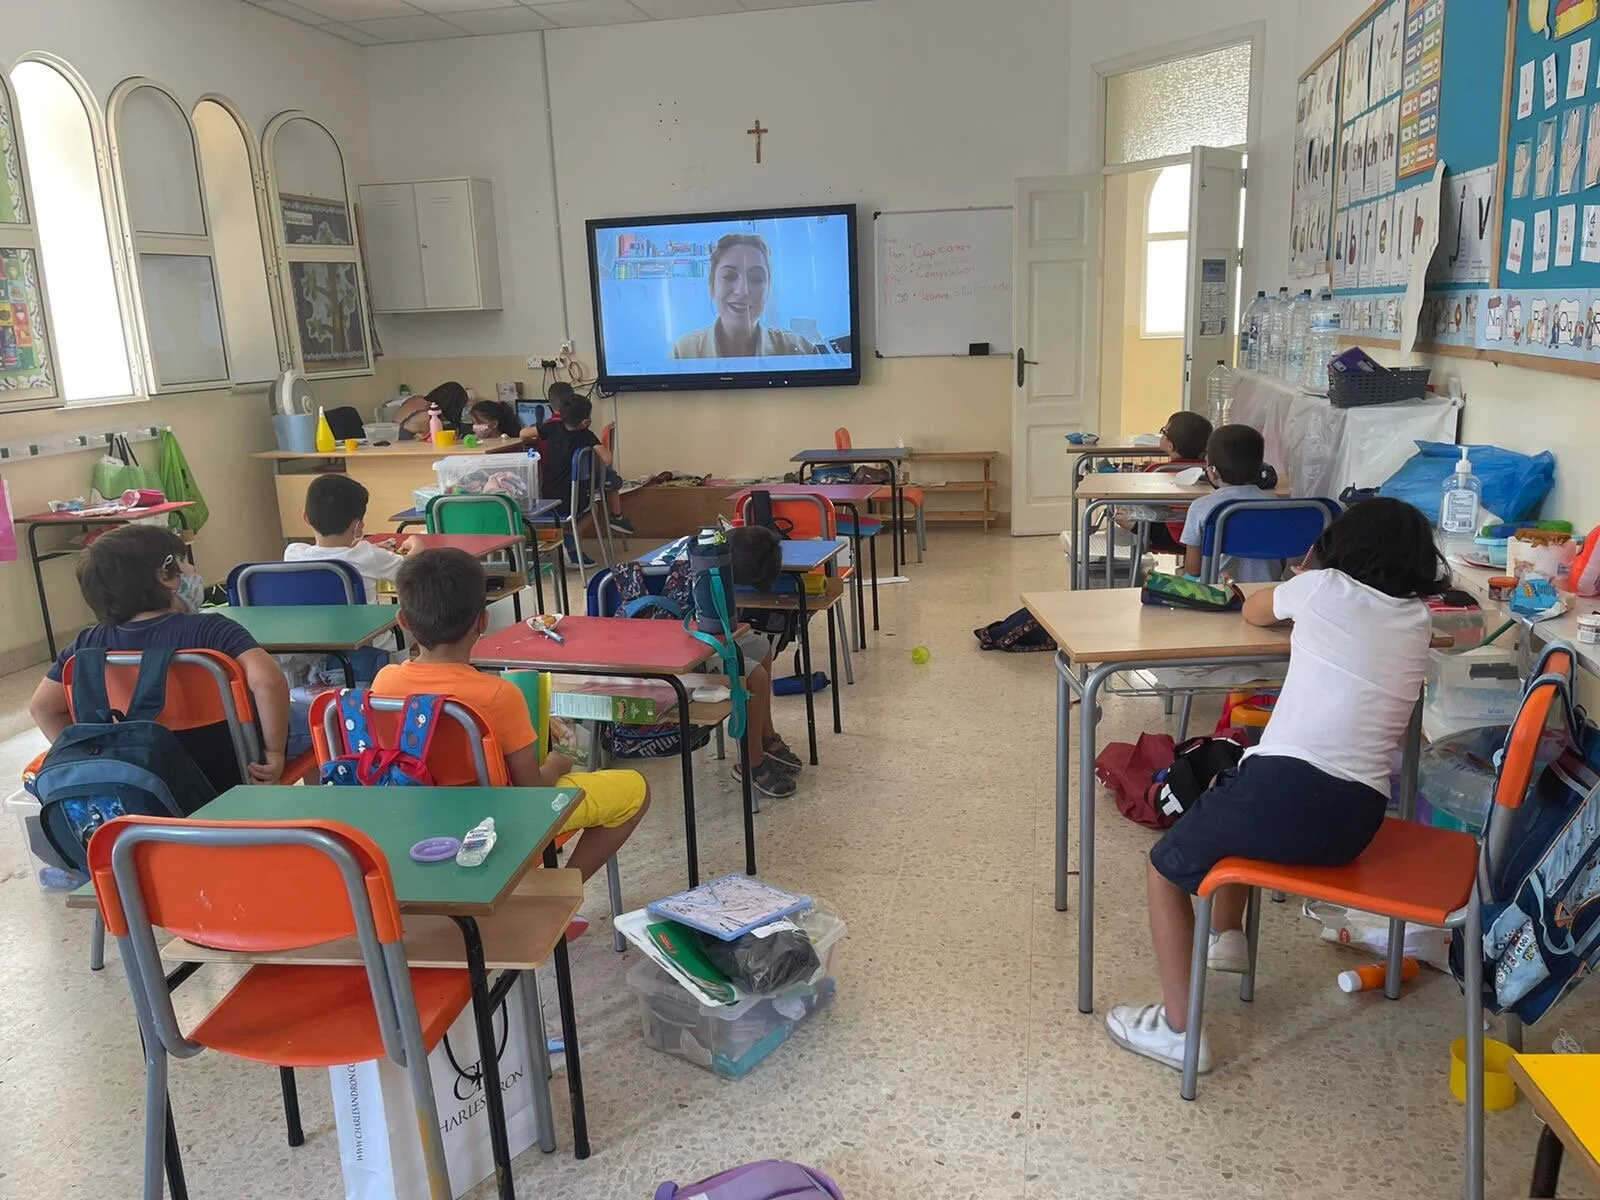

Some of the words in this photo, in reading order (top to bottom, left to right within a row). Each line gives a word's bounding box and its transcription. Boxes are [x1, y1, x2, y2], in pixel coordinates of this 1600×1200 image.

[1546, 60, 1551, 75] 2
[638, 735, 681, 757] SPIDE
[439, 1094, 486, 1133] HARLES
